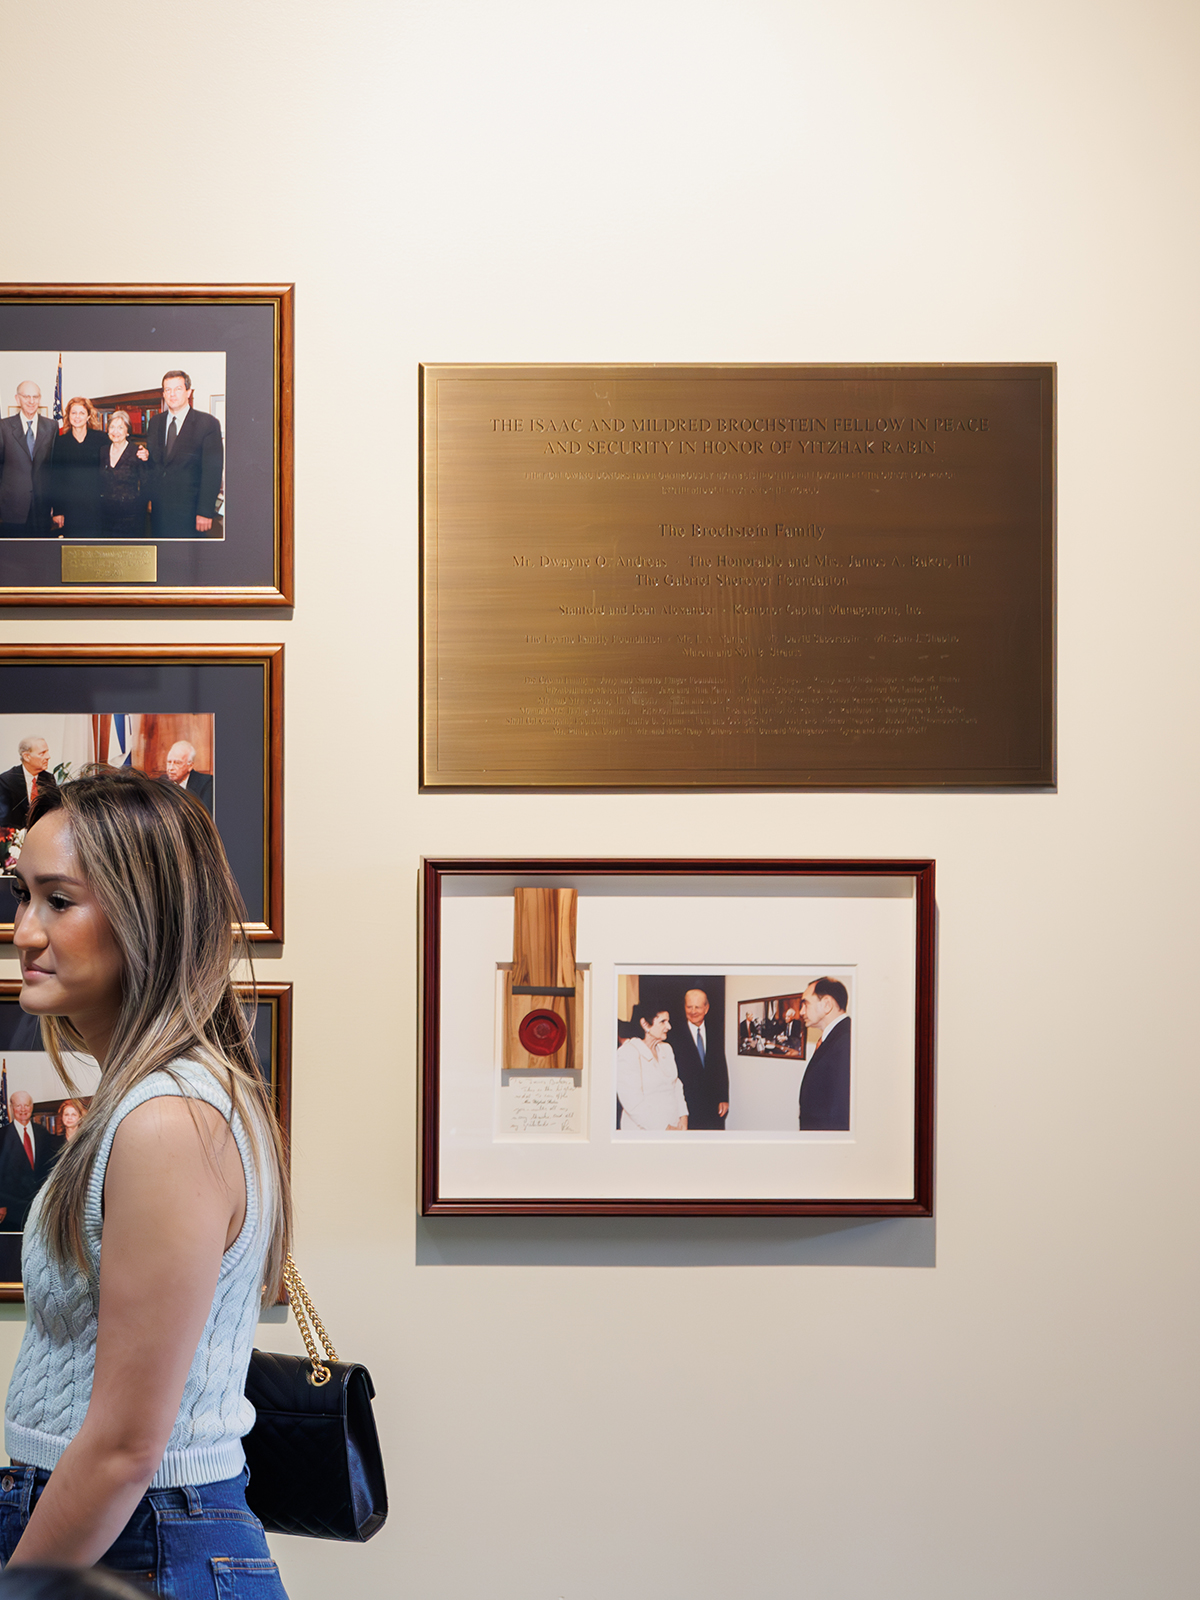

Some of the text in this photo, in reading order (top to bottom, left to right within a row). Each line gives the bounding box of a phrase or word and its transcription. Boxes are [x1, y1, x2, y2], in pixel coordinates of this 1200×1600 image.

[490, 418, 990, 433] THE ISAAC AND MILDRED BROCHSTEIN FELLOW IN PEACE
[544, 440, 936, 455] AND SECURITY IN HONOR OF YITZHAK RABIN
[658, 523, 826, 541] The Brochstein Family
[540, 555, 591, 571] Dwayne
[596, 555, 611, 568] O.
[616, 555, 668, 568] Andreas
[688, 555, 712, 568] The
[717, 555, 783, 568] Honorable
[788, 555, 810, 568] and
[815, 555, 843, 568] Mrs.
[849, 555, 886, 568] James
[891, 555, 905, 568] A.
[910, 555, 952, 570] Baker,
[956, 554, 971, 567] III
[635, 574, 659, 587] The
[664, 574, 711, 587] Gabriel
[777, 574, 849, 587] Foundation
[558, 604, 605, 616] Stanford
[608, 604, 628, 616] and
[661, 604, 715, 616] Alexander
[786, 604, 824, 617] Capital
[905, 604, 925, 616] Inc.
[524, 634, 541, 644] The
[578, 634, 608, 646] Family
[612, 634, 663, 644] Foundation
